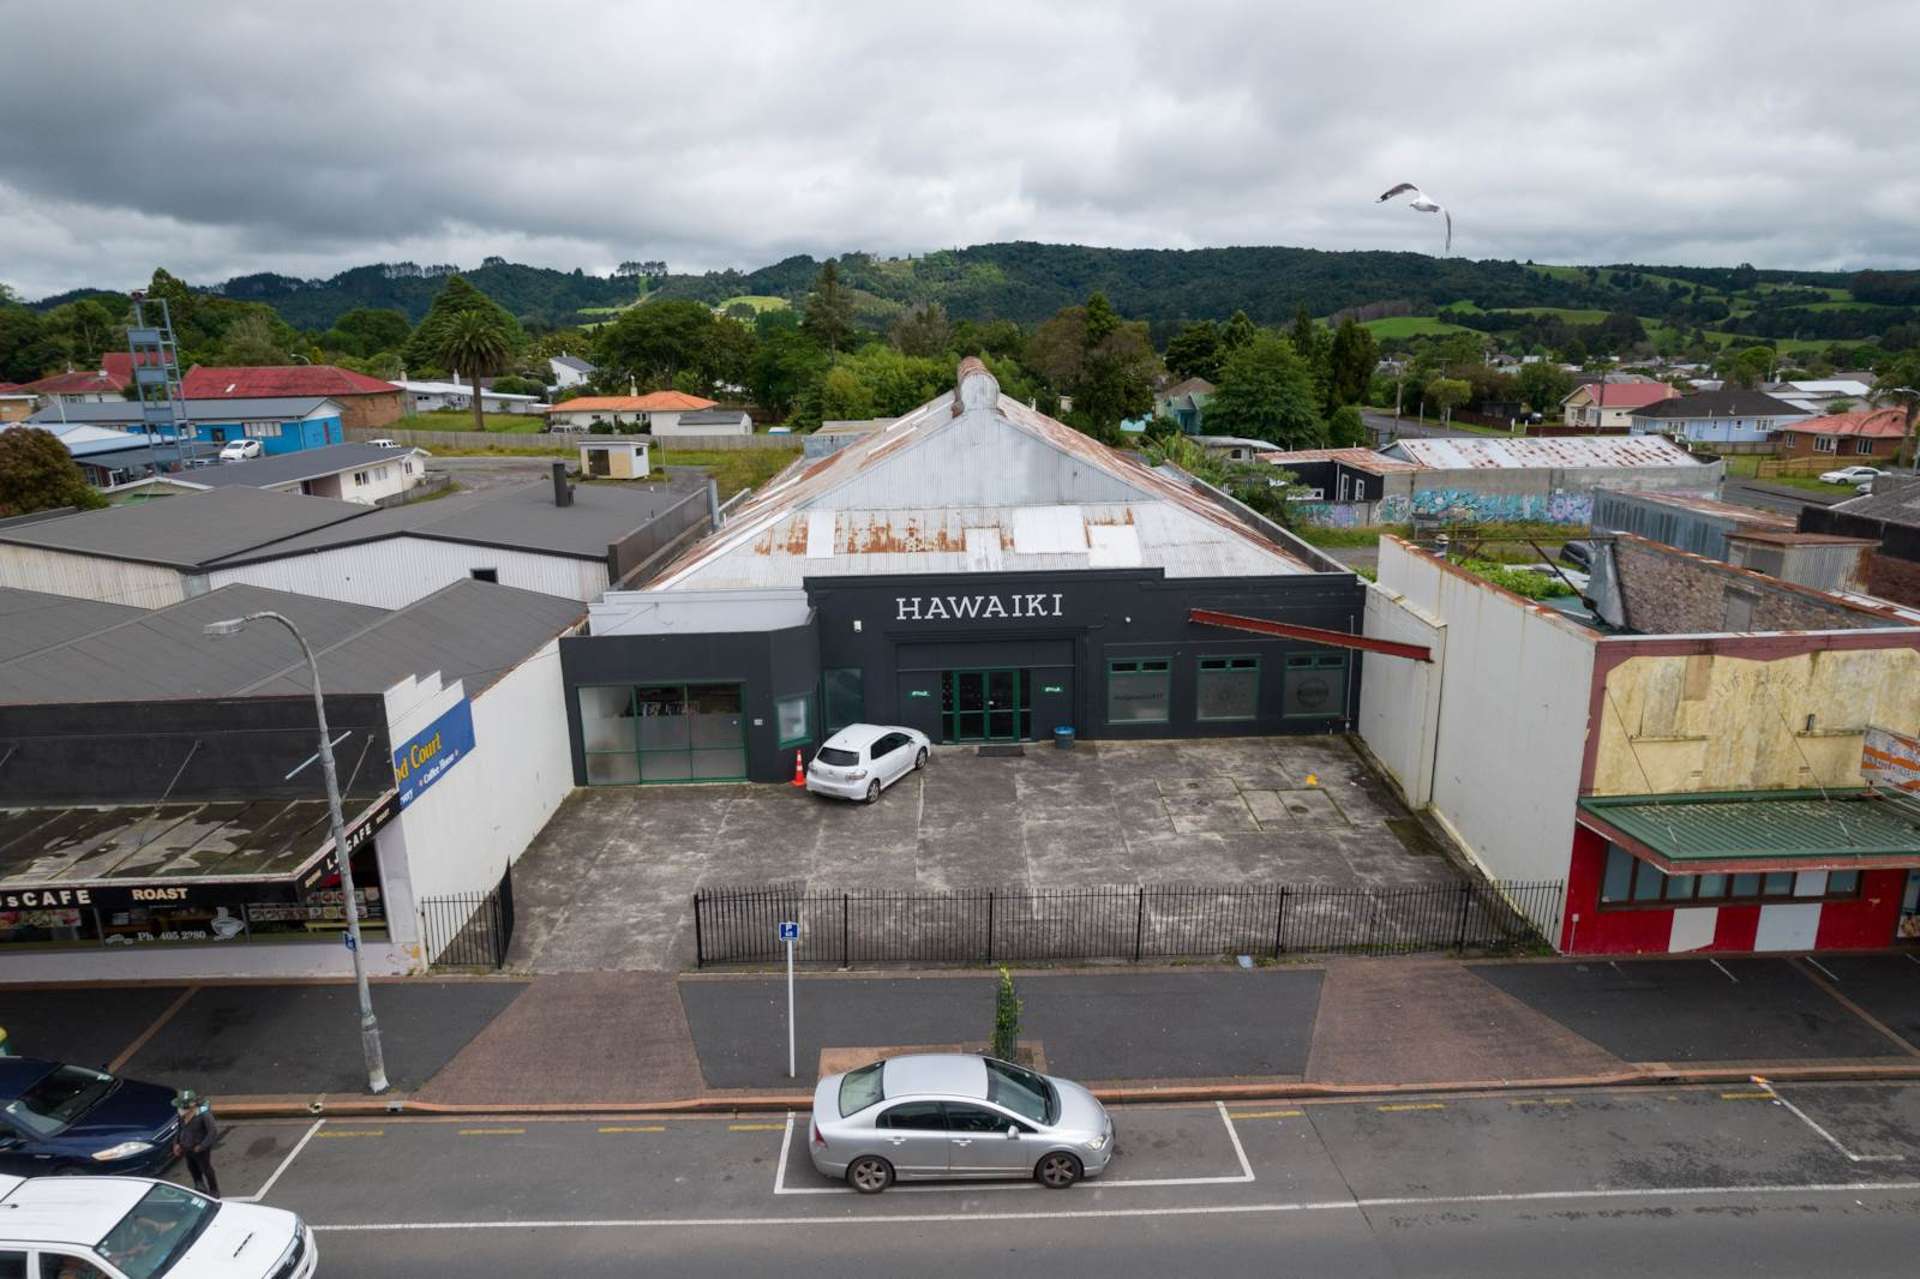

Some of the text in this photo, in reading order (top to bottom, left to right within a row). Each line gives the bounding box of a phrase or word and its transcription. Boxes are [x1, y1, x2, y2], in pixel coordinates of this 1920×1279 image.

[896, 594, 1063, 620] HAWAIKI
[410, 731, 442, 769] Court
[346, 823, 371, 853] CAFE
[132, 887, 188, 900] ROAST
[137, 932, 154, 941] Ph
